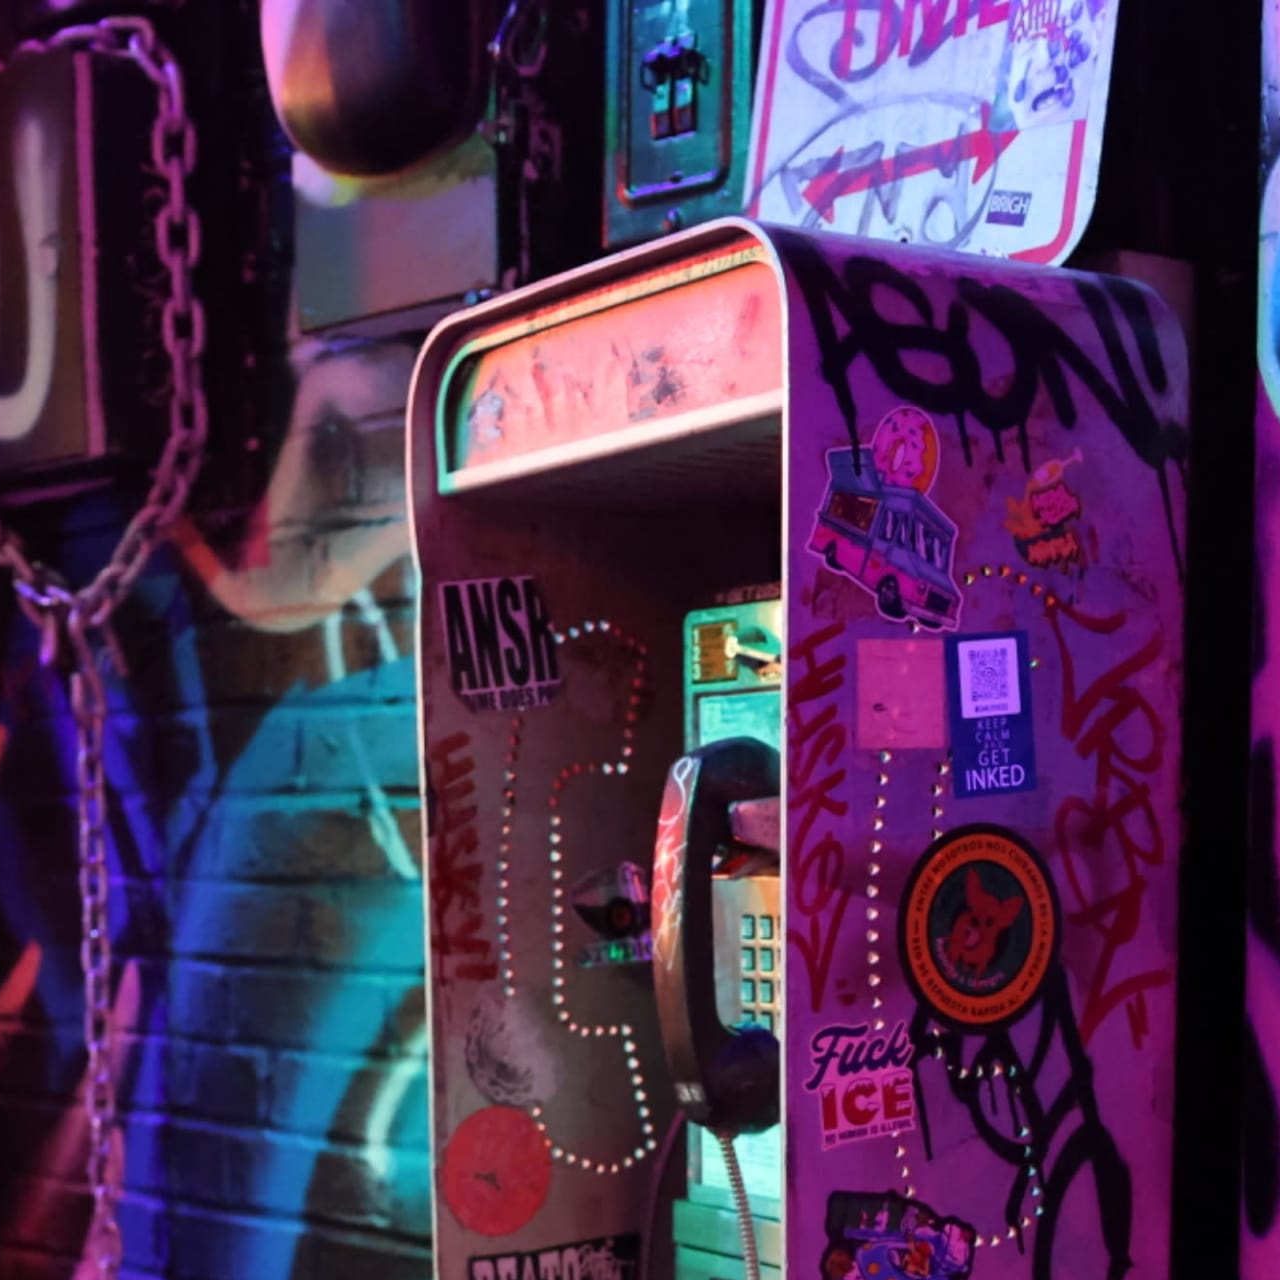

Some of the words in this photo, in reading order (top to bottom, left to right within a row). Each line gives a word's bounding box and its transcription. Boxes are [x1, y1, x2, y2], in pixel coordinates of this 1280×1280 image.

[977, 717, 1008, 731] KEEP
[975, 730, 1010, 743] CALM
[978, 748, 1011, 767] GET
[965, 764, 1025, 791] INKED
[805, 1021, 913, 1090] Fuck
[821, 1073, 913, 1131] ICE
